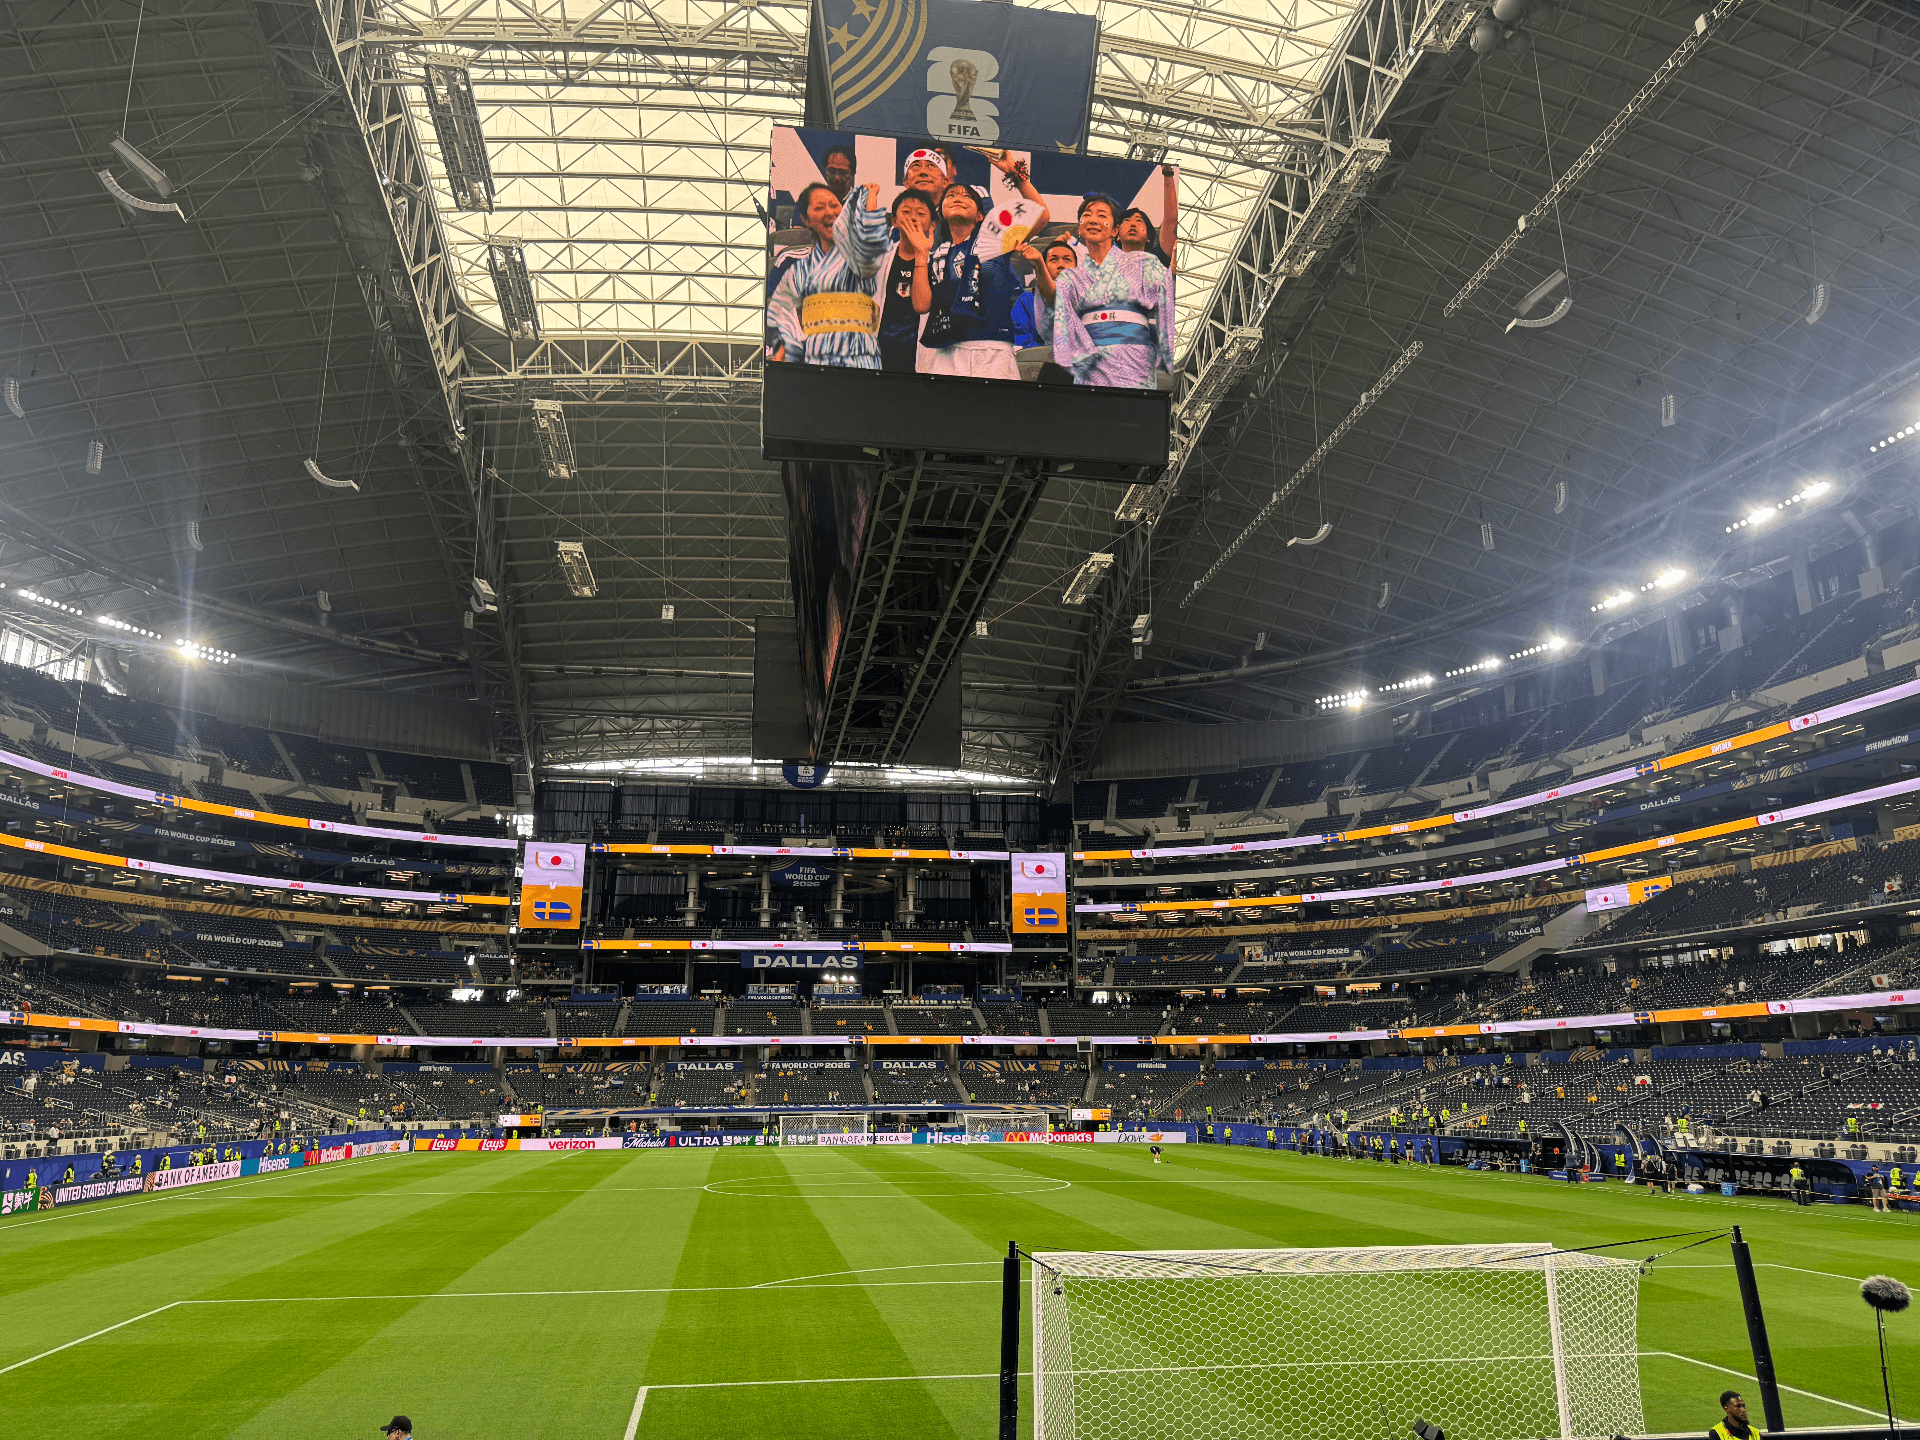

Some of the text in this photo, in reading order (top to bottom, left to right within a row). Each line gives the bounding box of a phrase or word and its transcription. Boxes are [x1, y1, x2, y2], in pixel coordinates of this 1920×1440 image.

[948, 123, 980, 137] FIFA
[1711, 740, 1732, 754] SWEDEN
[51, 768, 68, 779] JAPAN
[0, 793, 40, 810] DALLAS
[1640, 795, 1681, 811] DALLAS
[155, 828, 236, 847] FIFA WORLD CUP 2026
[351, 856, 396, 866] DALLAS
[800, 866, 817, 874] FIFA
[785, 873, 814, 881] WORLD
[1507, 926, 1541, 938] DALLAS
[196, 933, 284, 948] FIFA WORLD CUP 2026
[753, 955, 859, 968] DALLAS
[677, 1062, 735, 1070] DALLAS
[882, 1061, 937, 1069] DALLAS
[549, 1138, 595, 1149] verizon
[623, 1136, 720, 1149] Michelob ULTRA
[926, 1132, 990, 1144] Hisense
[1118, 1132, 1145, 1143] Dove
[432, 1139, 456, 1149] Lay's
[482, 1139, 507, 1149] Lay's
[258, 1157, 290, 1173] Hisense
[158, 1163, 230, 1187] BANK OF AMERICA
[55, 1176, 143, 1203] UNITED STATES OF AMERICA
